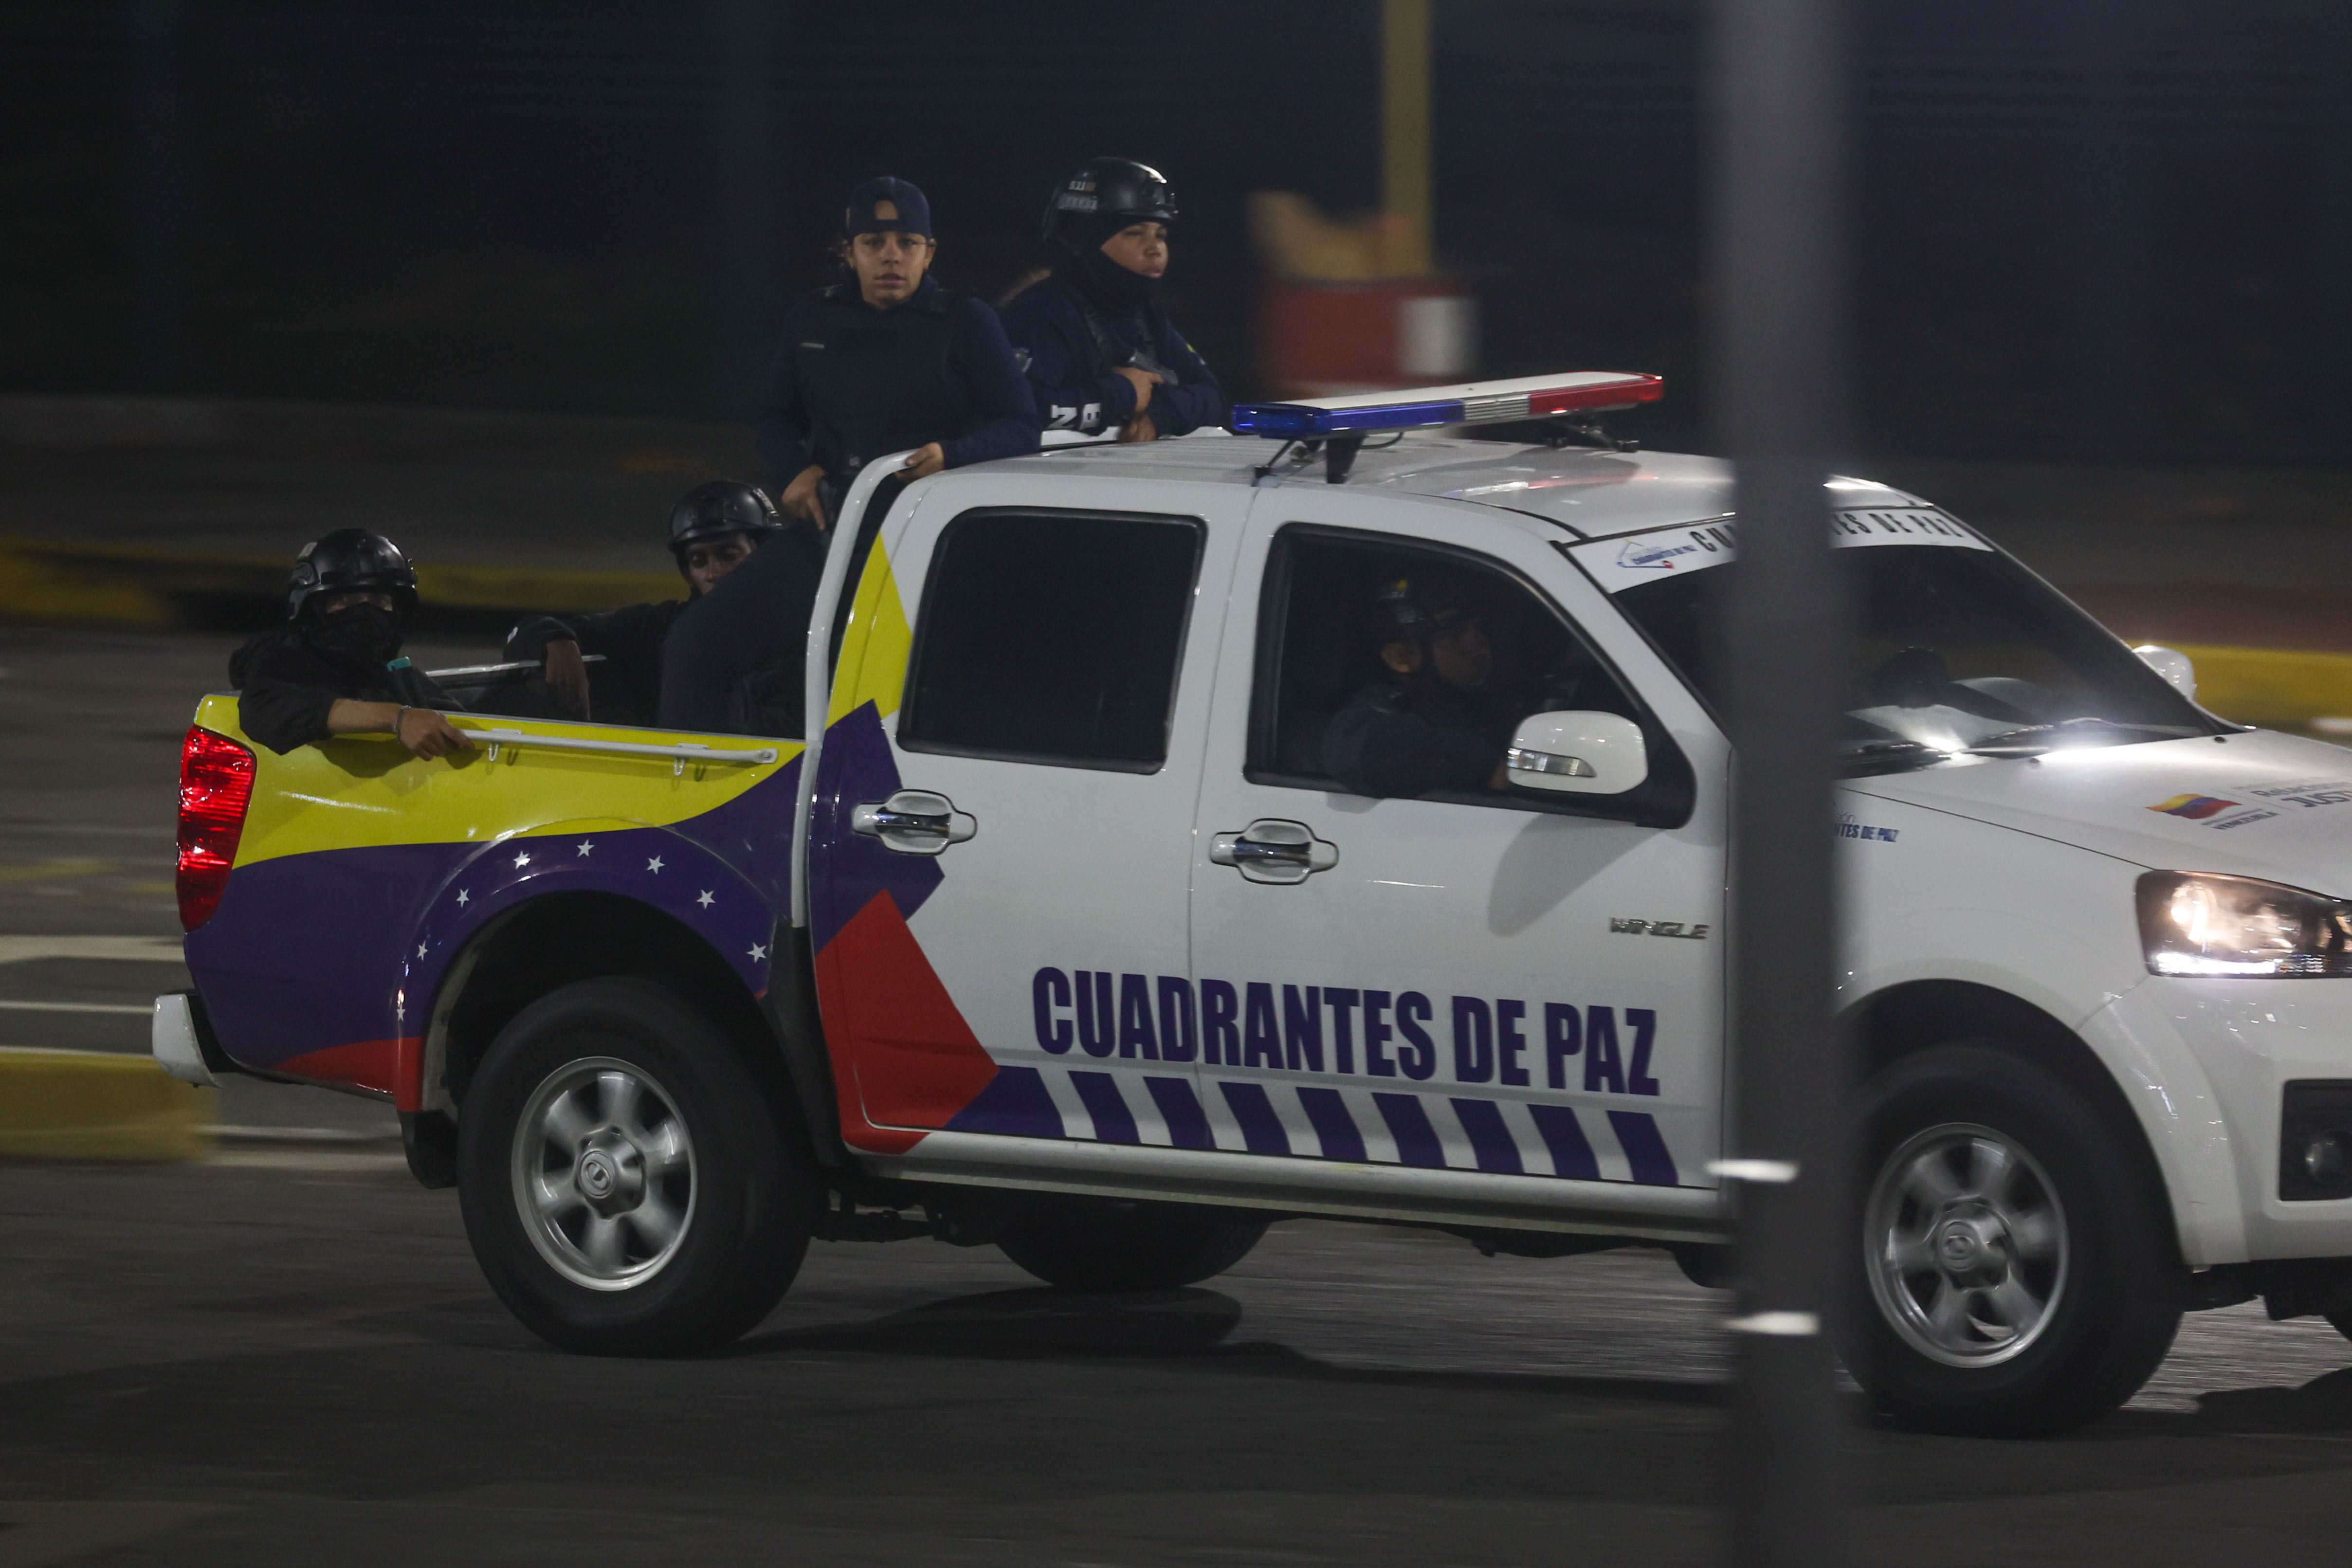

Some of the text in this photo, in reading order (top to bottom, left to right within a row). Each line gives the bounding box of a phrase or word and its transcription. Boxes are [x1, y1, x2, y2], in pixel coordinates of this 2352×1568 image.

[1868, 513, 1912, 533] DE
[1033, 966, 1660, 1096] CUADRANTES DE PAZ
